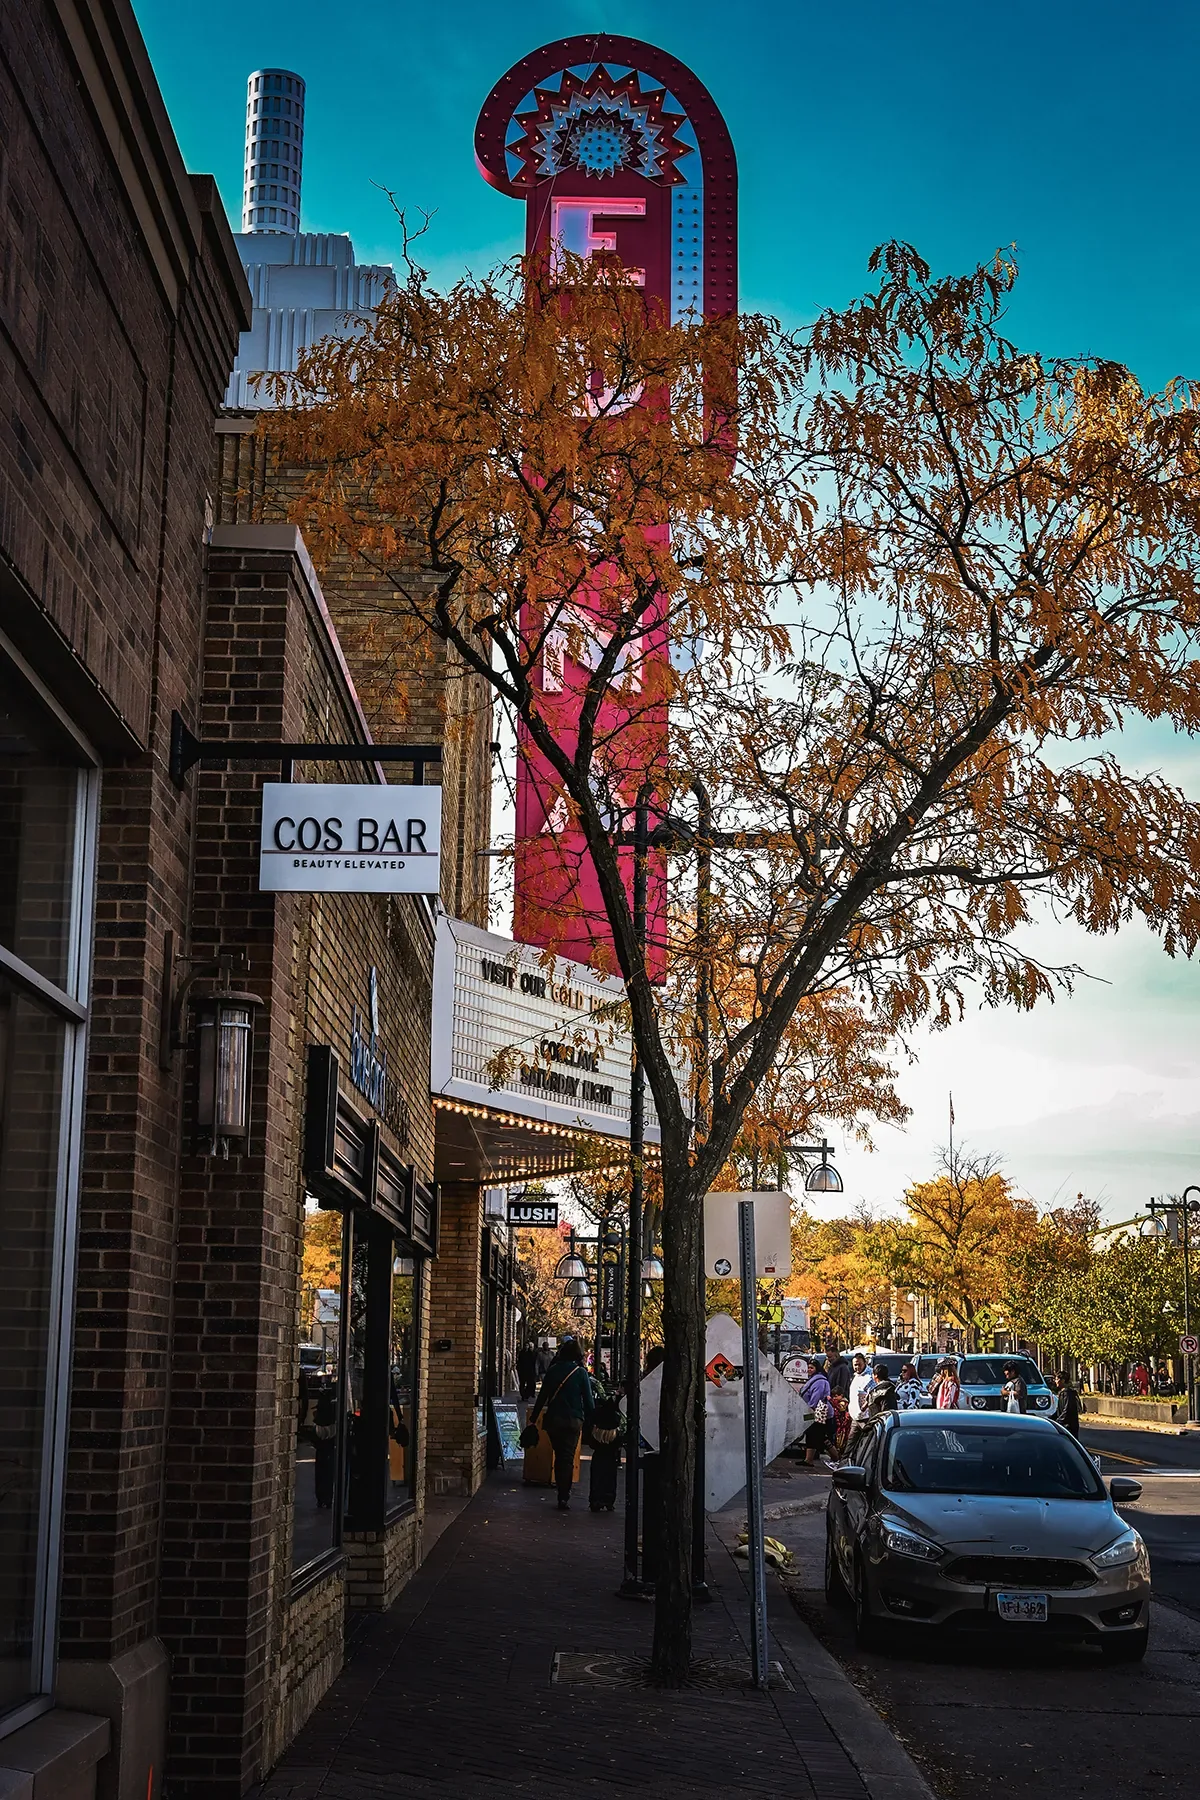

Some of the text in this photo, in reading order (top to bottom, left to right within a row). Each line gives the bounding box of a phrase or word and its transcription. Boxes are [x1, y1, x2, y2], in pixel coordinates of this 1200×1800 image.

[273, 816, 427, 853] COS BAR
[293, 859, 406, 869] BEAUTY ELEVATED
[481, 958, 514, 988] VISIT
[521, 973, 545, 997] OUR
[551, 984, 584, 1009] GOLD
[520, 1068, 614, 1105] SATURDAY NIGHT
[510, 1207, 556, 1220] LUSH
